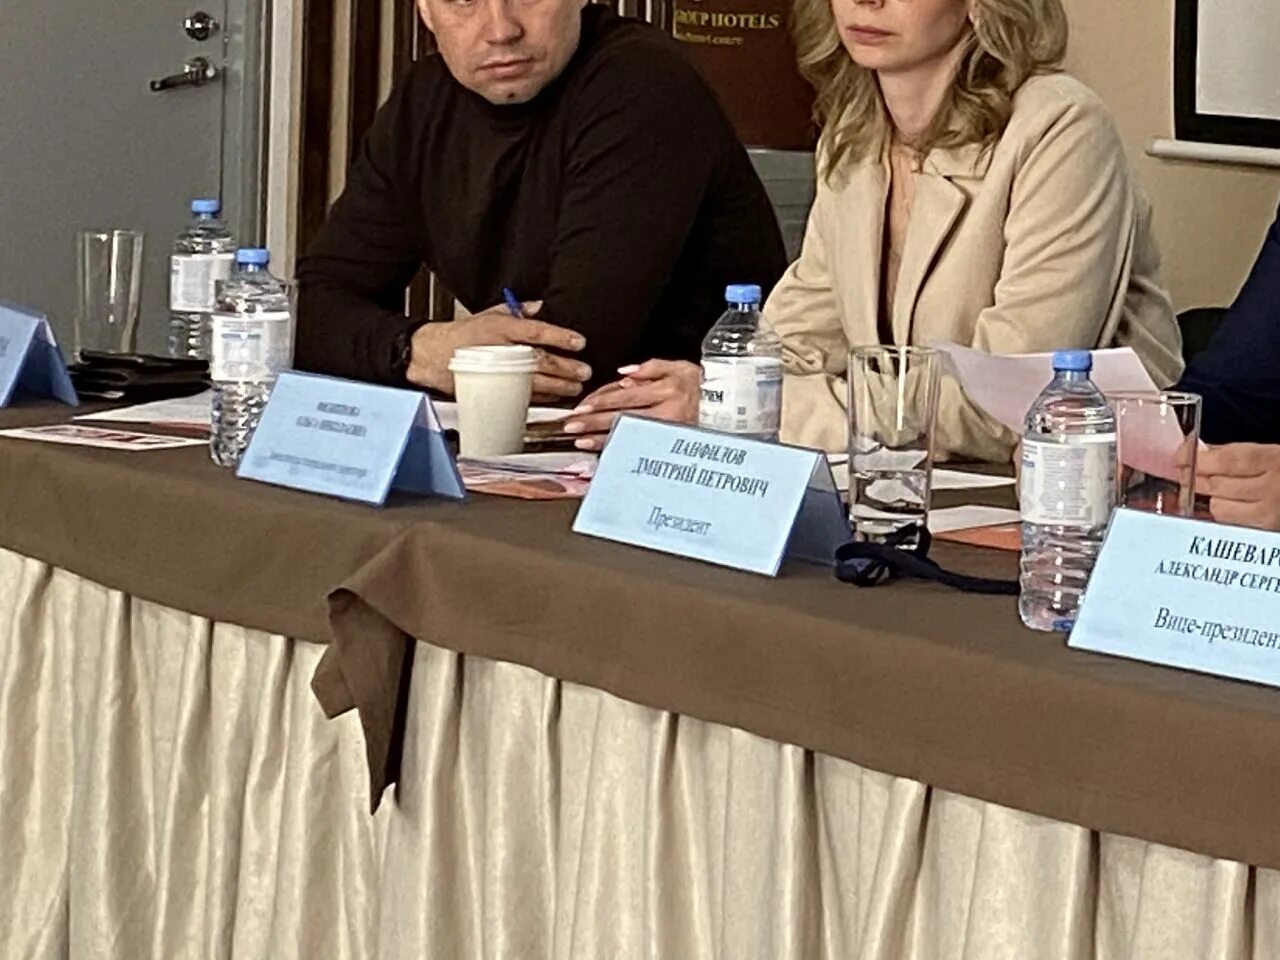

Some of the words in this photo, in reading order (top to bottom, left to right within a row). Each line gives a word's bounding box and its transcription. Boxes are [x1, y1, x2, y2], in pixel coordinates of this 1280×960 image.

[670, 438, 747, 466] ПАНФИЛОВ
[631, 456, 698, 483] ДМИТРИЙ
[696, 467, 769, 498] ПЕТРОВИЧ
[646, 505, 712, 536] Президент
[1154, 559, 1240, 587] АЛЕКСАНДР
